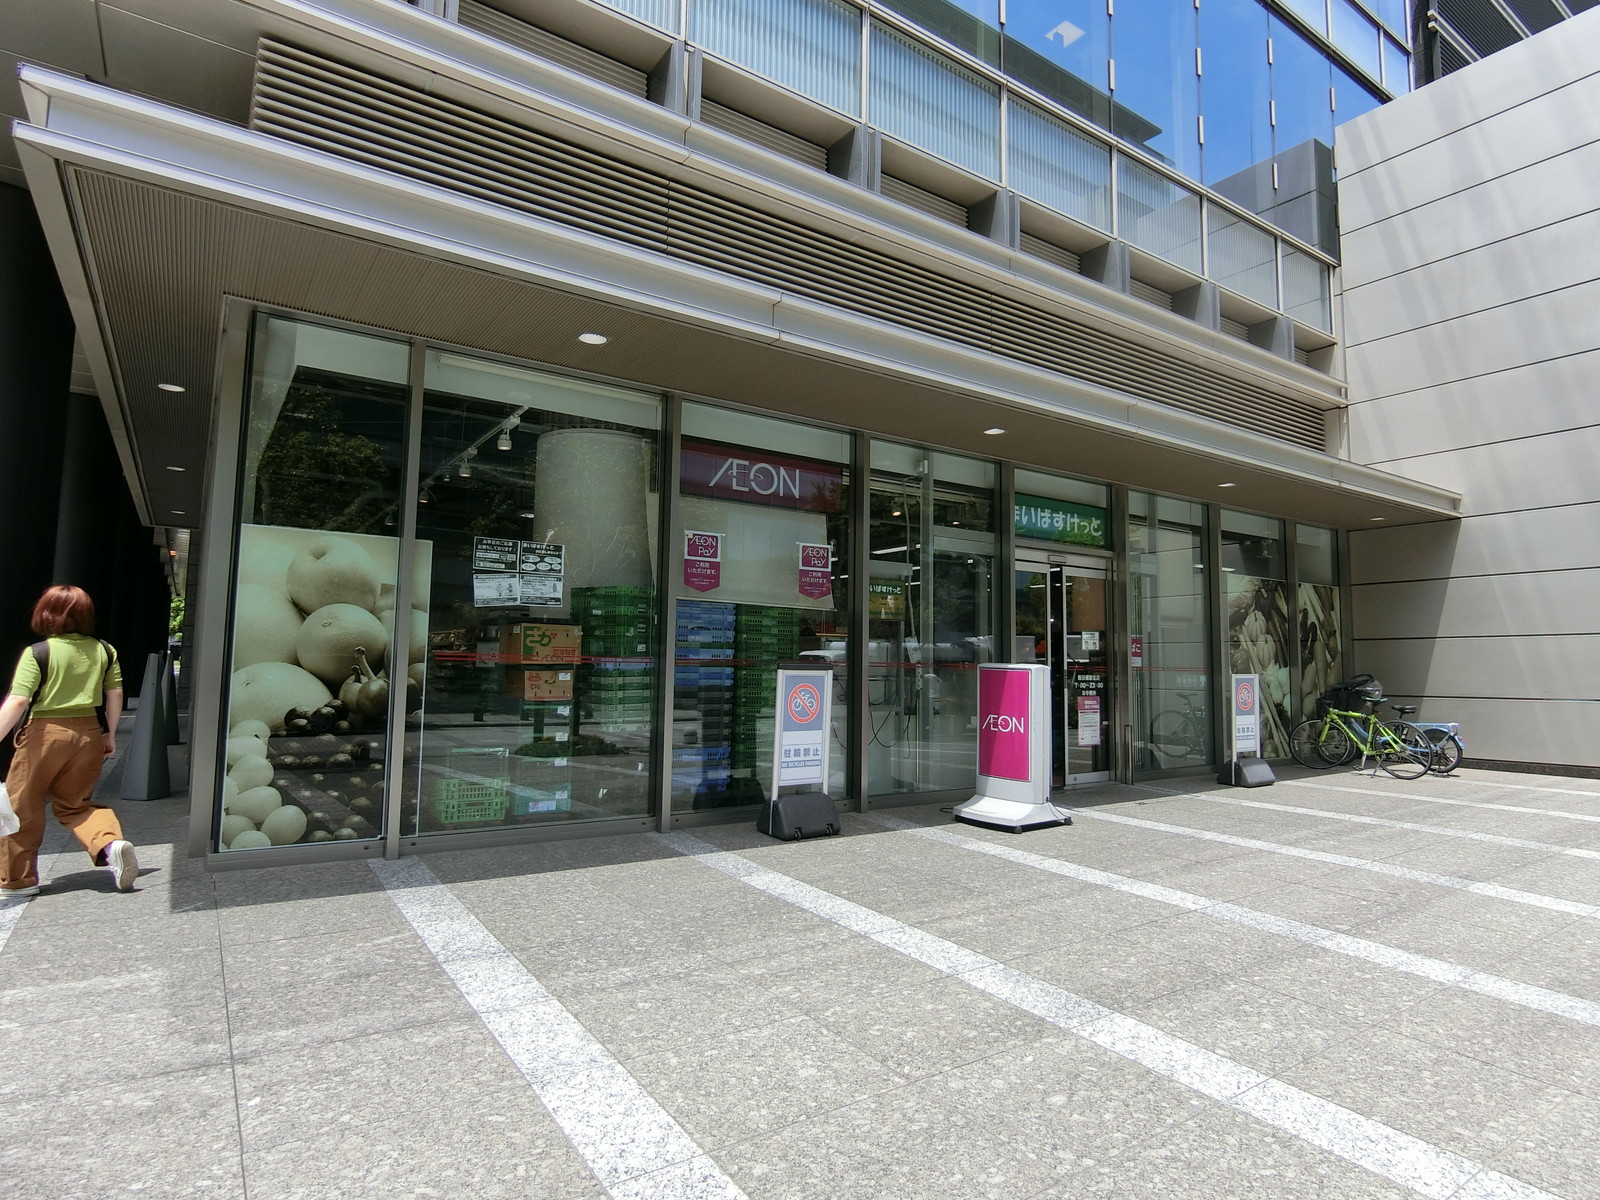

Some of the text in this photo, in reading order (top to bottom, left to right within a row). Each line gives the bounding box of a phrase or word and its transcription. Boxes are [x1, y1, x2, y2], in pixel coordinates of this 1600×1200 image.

[695, 561, 710, 569] ご利用
[784, 747, 820, 758] 駐輪禁止
